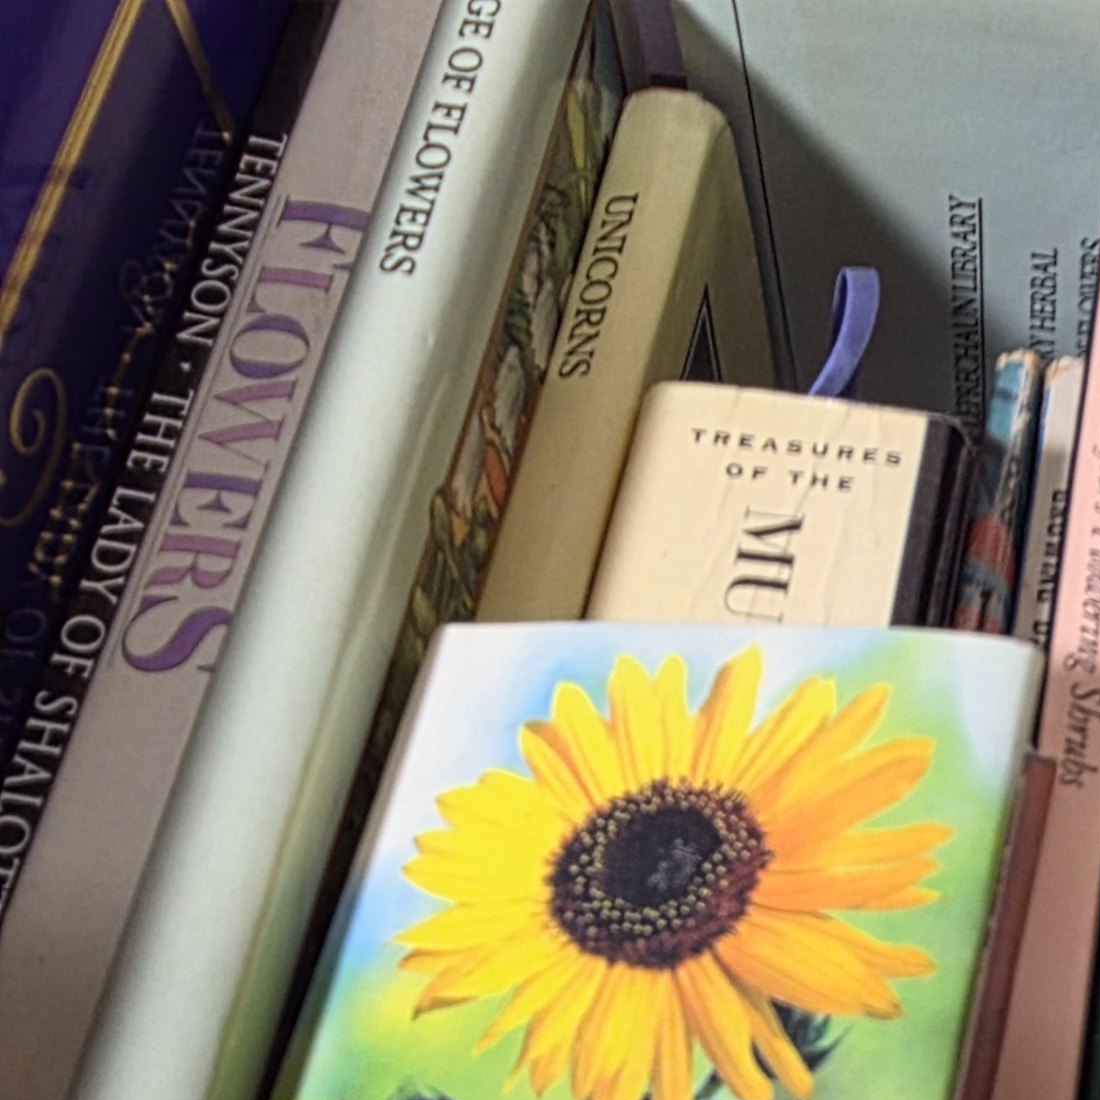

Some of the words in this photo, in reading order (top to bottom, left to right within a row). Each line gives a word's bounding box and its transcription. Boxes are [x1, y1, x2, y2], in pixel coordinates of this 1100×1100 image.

[441, 46, 484, 95] OF
[379, 100, 468, 276] FLOWERS
[176, 134, 288, 347] TENNYSON
[558, 191, 640, 380] UNICORNS
[1029, 246, 1058, 330] HERBAL
[122, 194, 372, 675] FLOWERS
[126, 387, 195, 476] THE
[690, 427, 903, 466] TREASURES
[725, 461, 770, 481] OF
[787, 470, 855, 493] THE
[79, 485, 156, 605] LADY
[50, 613, 107, 680] OF
[0, 689, 79, 908] SHALOT
